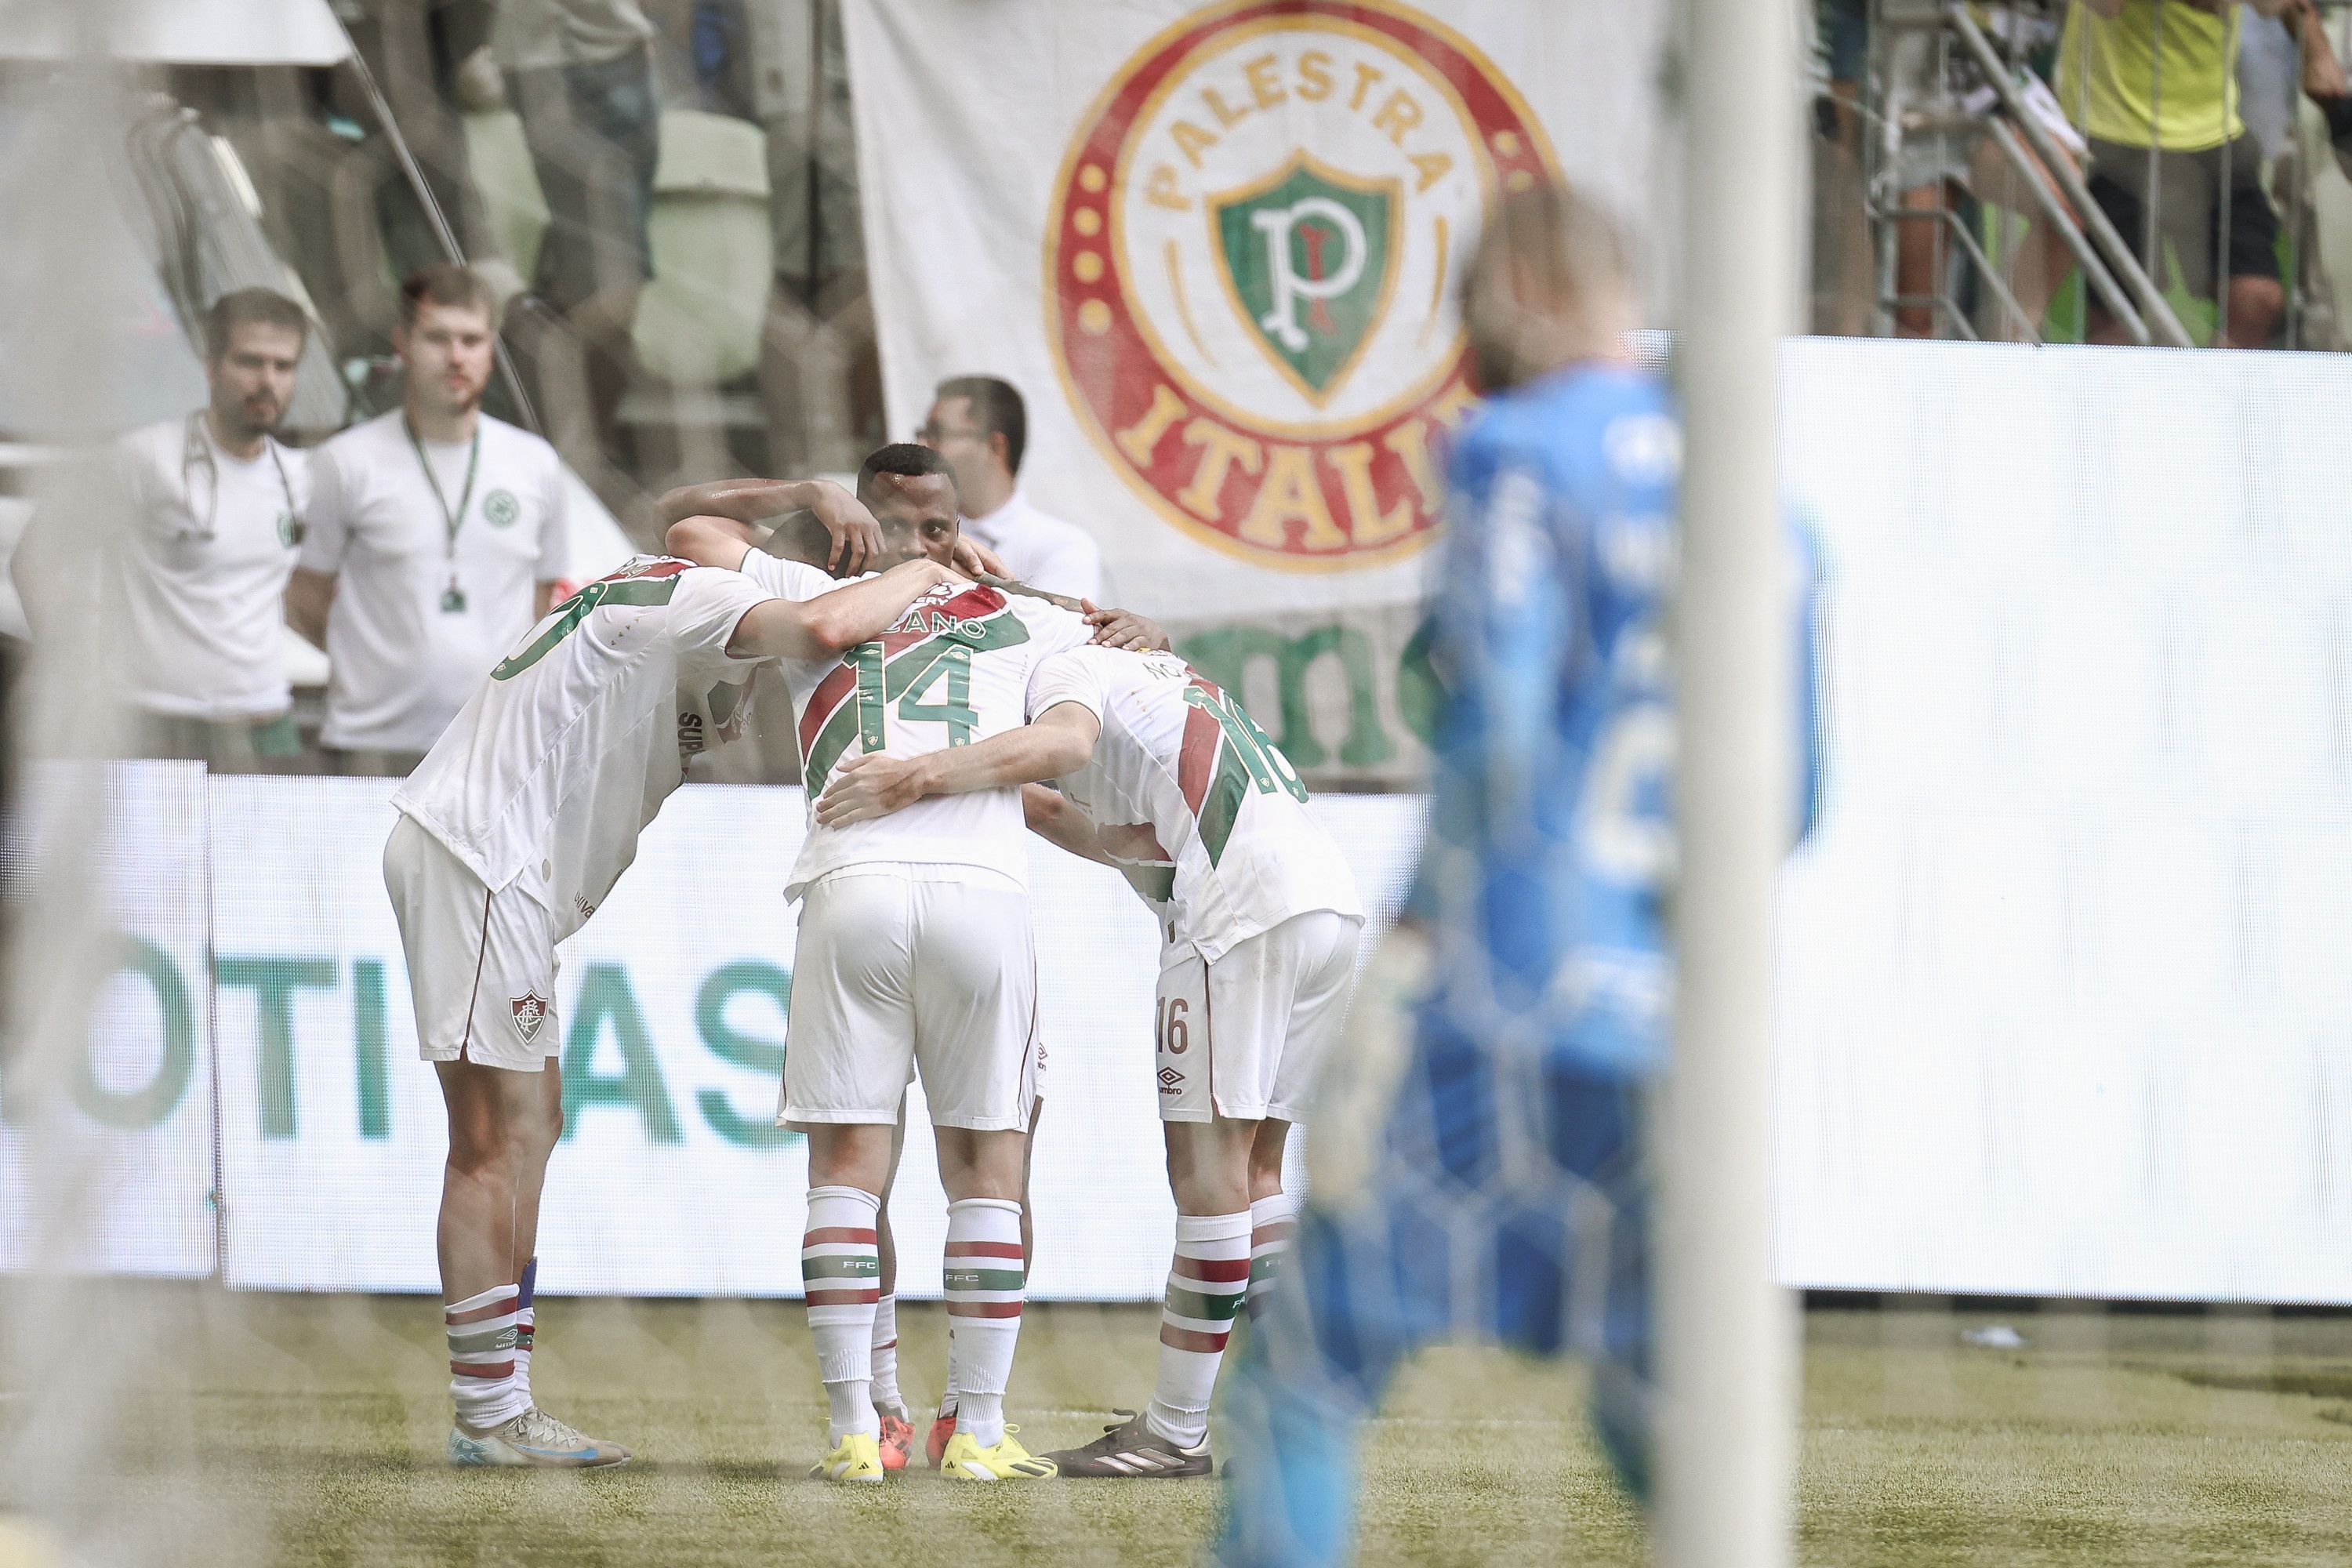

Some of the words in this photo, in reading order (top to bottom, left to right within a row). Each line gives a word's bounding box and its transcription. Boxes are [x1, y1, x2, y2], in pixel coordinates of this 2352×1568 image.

[1145, 49, 1455, 213] PALESTRA
[880, 609, 987, 640] ANO
[914, 596, 949, 608] ERY
[841, 640, 980, 754] 14
[677, 711, 703, 760] SUP
[1182, 685, 1310, 804] 16
[0, 933, 809, 1149] OTIAS
[1157, 996, 1189, 1054] 16
[1159, 1083, 1182, 1095] umbro
[843, 1261, 876, 1269] FFC
